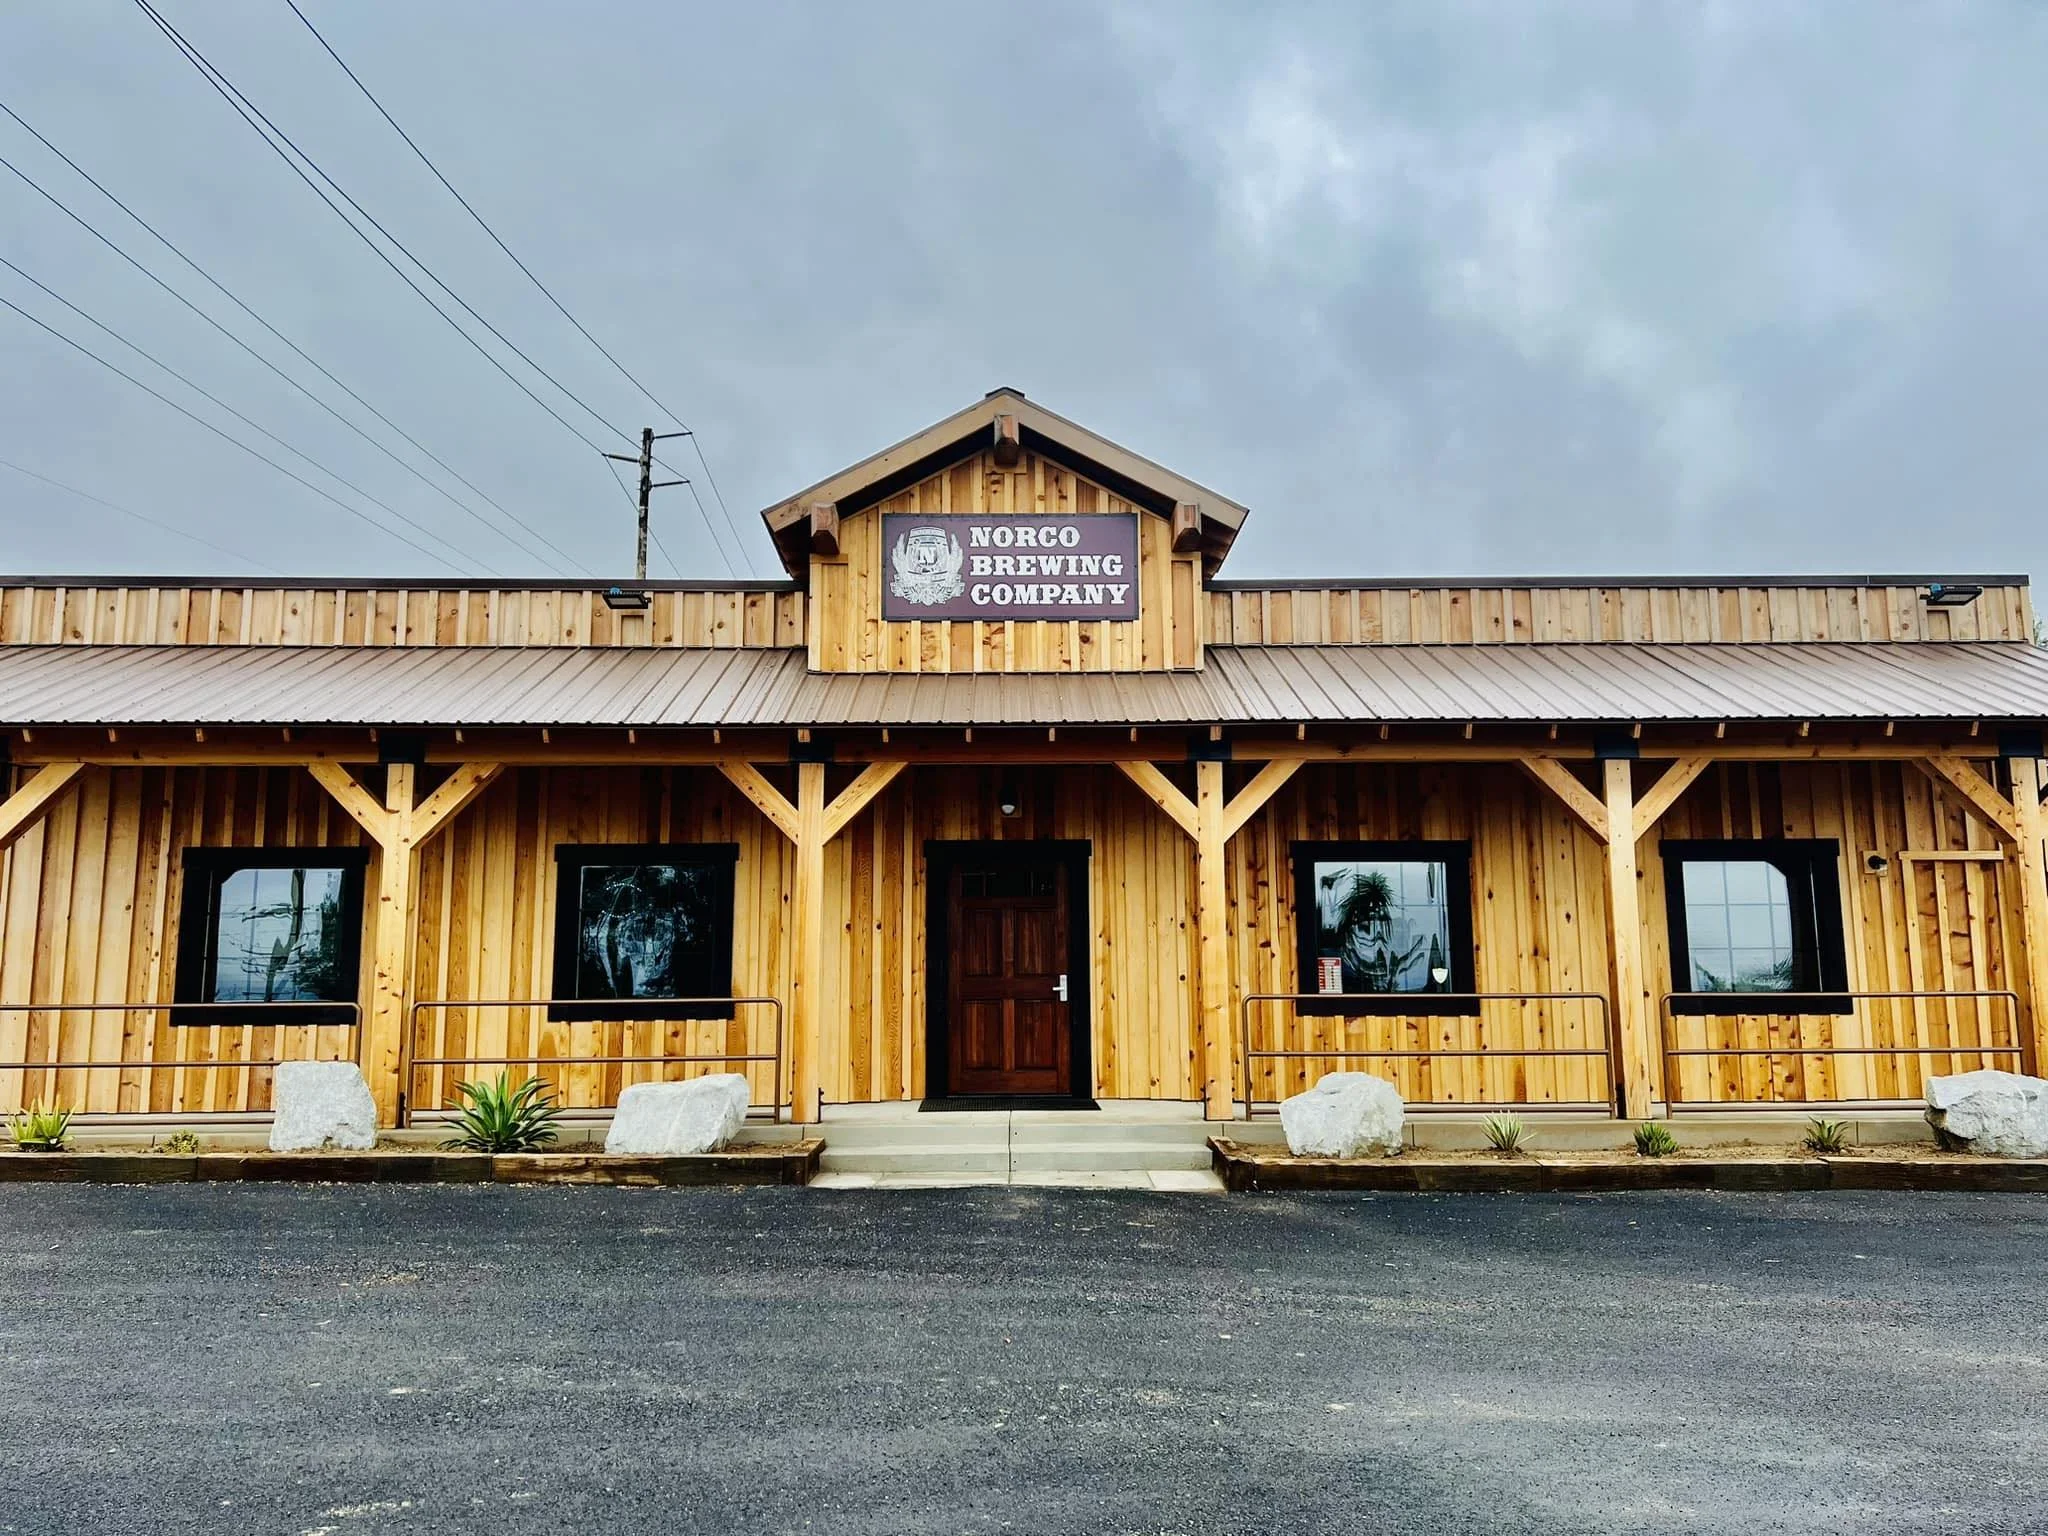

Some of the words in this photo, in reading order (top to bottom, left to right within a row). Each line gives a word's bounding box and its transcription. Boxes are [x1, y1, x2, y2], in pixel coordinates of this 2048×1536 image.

[970, 526, 1080, 547] NORCO
[918, 546, 936, 564] N
[970, 555, 1123, 576] BREWING
[970, 584, 1130, 605] COMPANY
